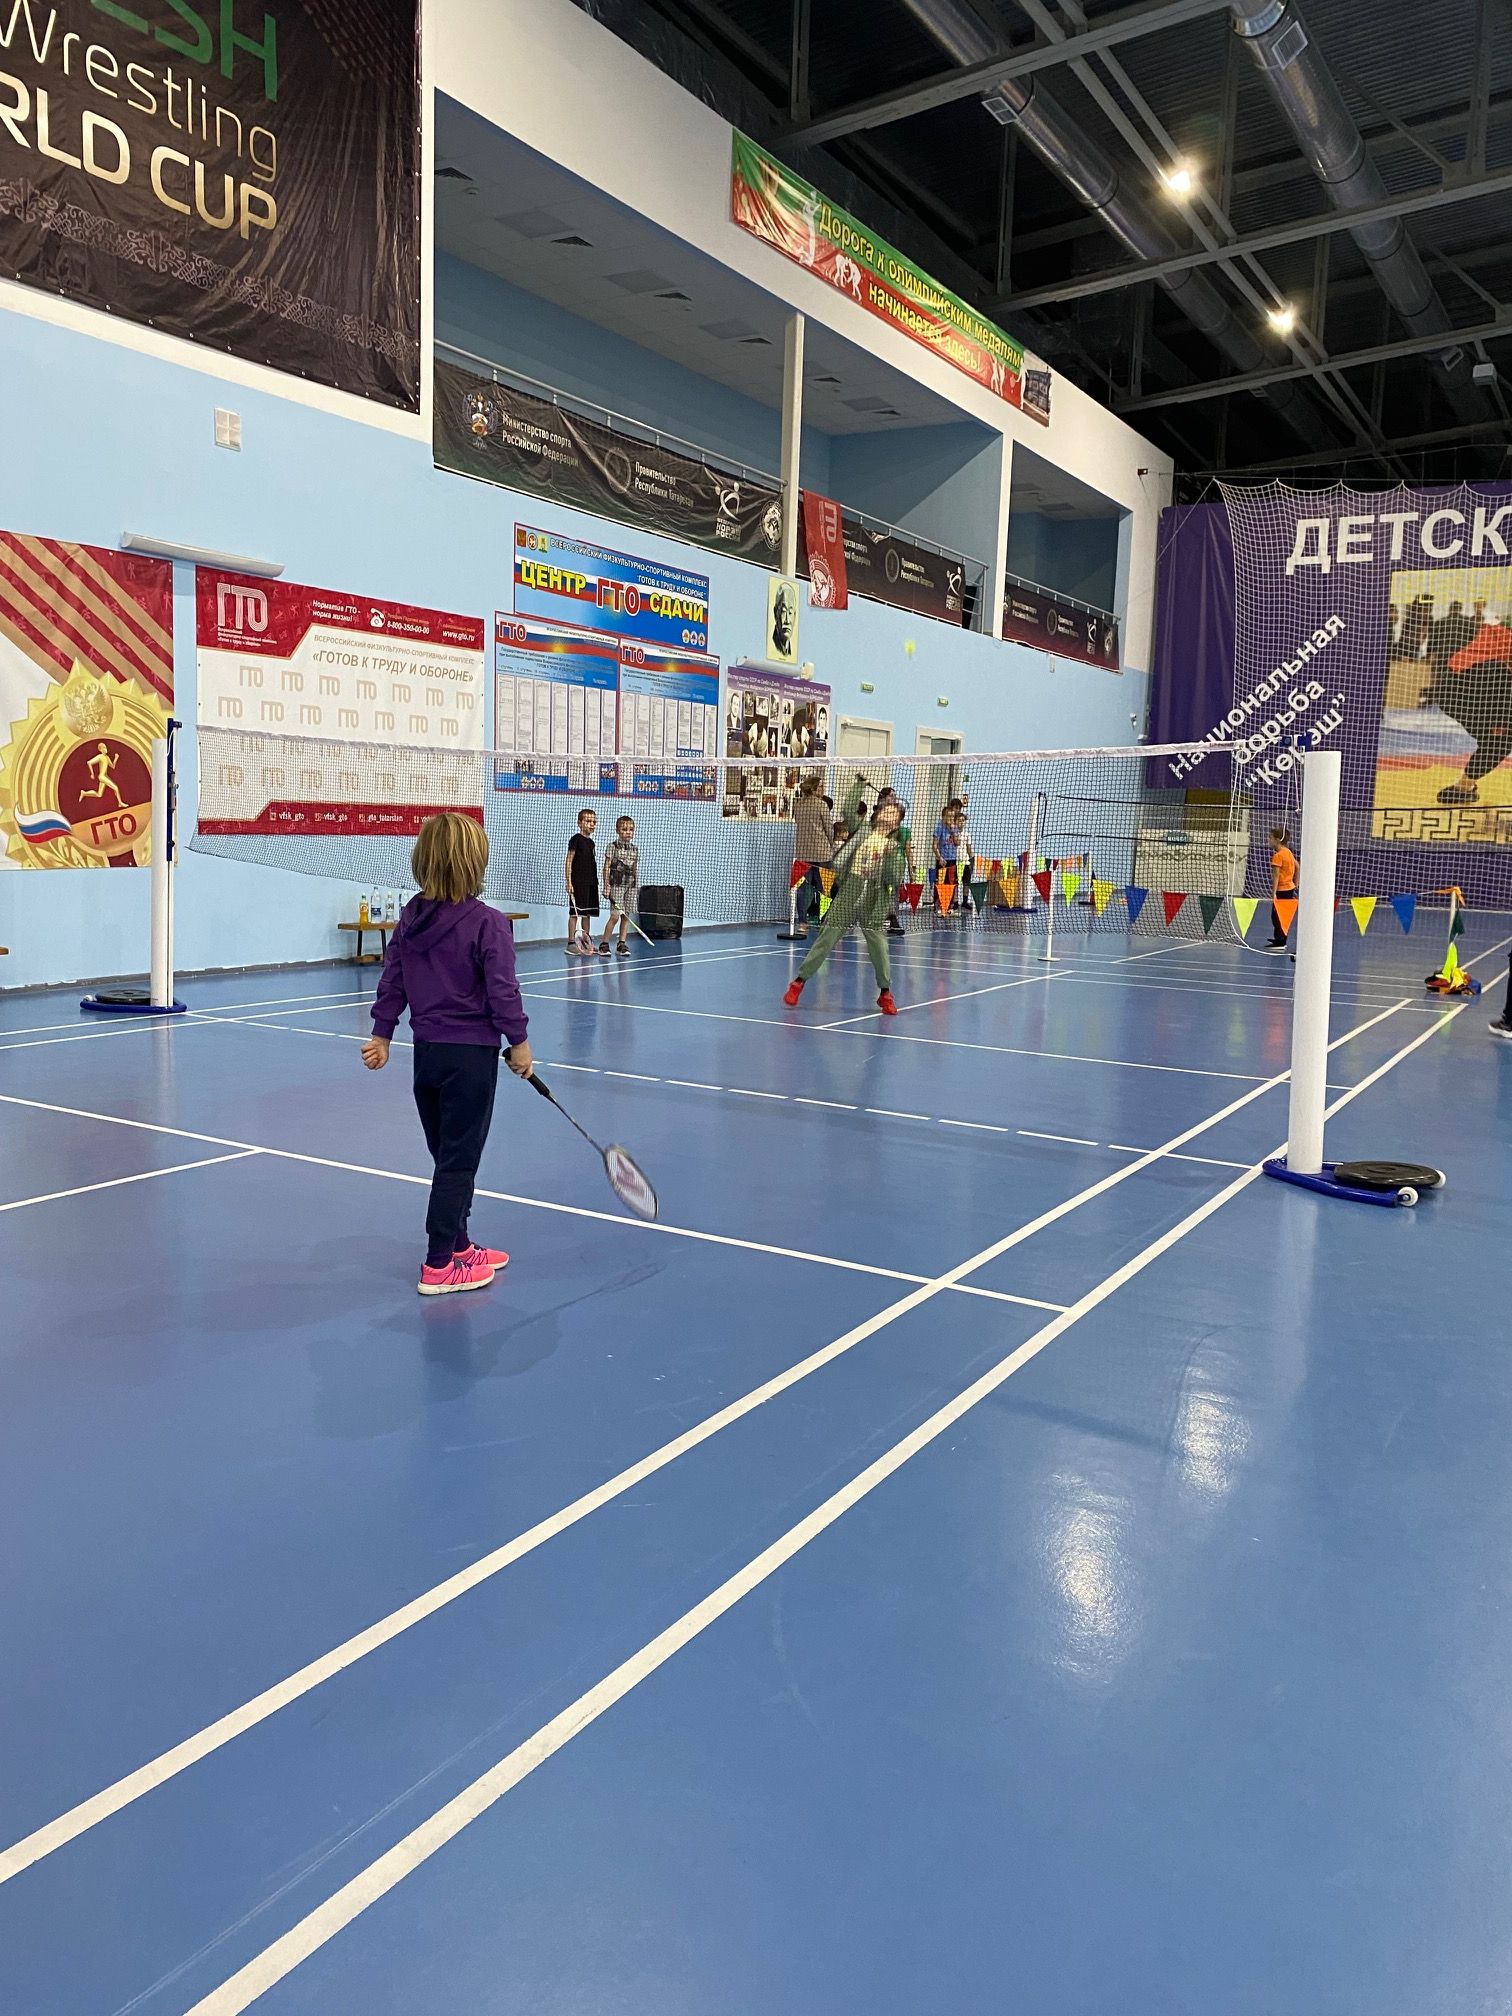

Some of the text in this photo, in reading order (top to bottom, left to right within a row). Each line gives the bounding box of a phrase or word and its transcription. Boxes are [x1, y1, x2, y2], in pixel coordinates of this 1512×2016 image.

[150, 145, 278, 240] CUP
[819, 202, 875, 263] Дорога
[876, 250, 886, 273] к
[889, 260, 973, 332] олимпийским
[502, 414, 572, 449] Министерство спорта
[502, 430, 541, 455] Российской
[542, 444, 579, 466] Федерации
[635, 461, 676, 486] Правительство
[635, 478, 668, 499] Республики
[824, 502, 838, 543] ГТО
[1286, 504, 1512, 576] ДЕТСК
[551, 537, 602, 560] ВСЕРОССИЙСКИЙ
[682, 574, 707, 588] КОМПЛЕКС
[217, 582, 268, 632] ГТО
[345, 604, 358, 614] ГТО
[521, 560, 705, 623] ЦЕНТР ГТО СДАЧИ
[312, 610, 331, 621] норма
[498, 620, 527, 642] ГТО
[314, 634, 366, 649] ВСЕРОССИЙСКИЙ
[442, 630, 475, 642] www.gto.ru
[313, 650, 474, 683] «ГОТОВ К ТРУДУ И ОБОРОНЕ»
[621, 645, 645, 664] ГТО
[239, 665, 474, 710] ГТО ГТО ГТО ГТО ГТО ГТО ГТО
[218, 696, 459, 736] ГТО ГТО ГТО ГТО ГТО ГТО ГТО
[91, 813, 137, 845] ГТО
